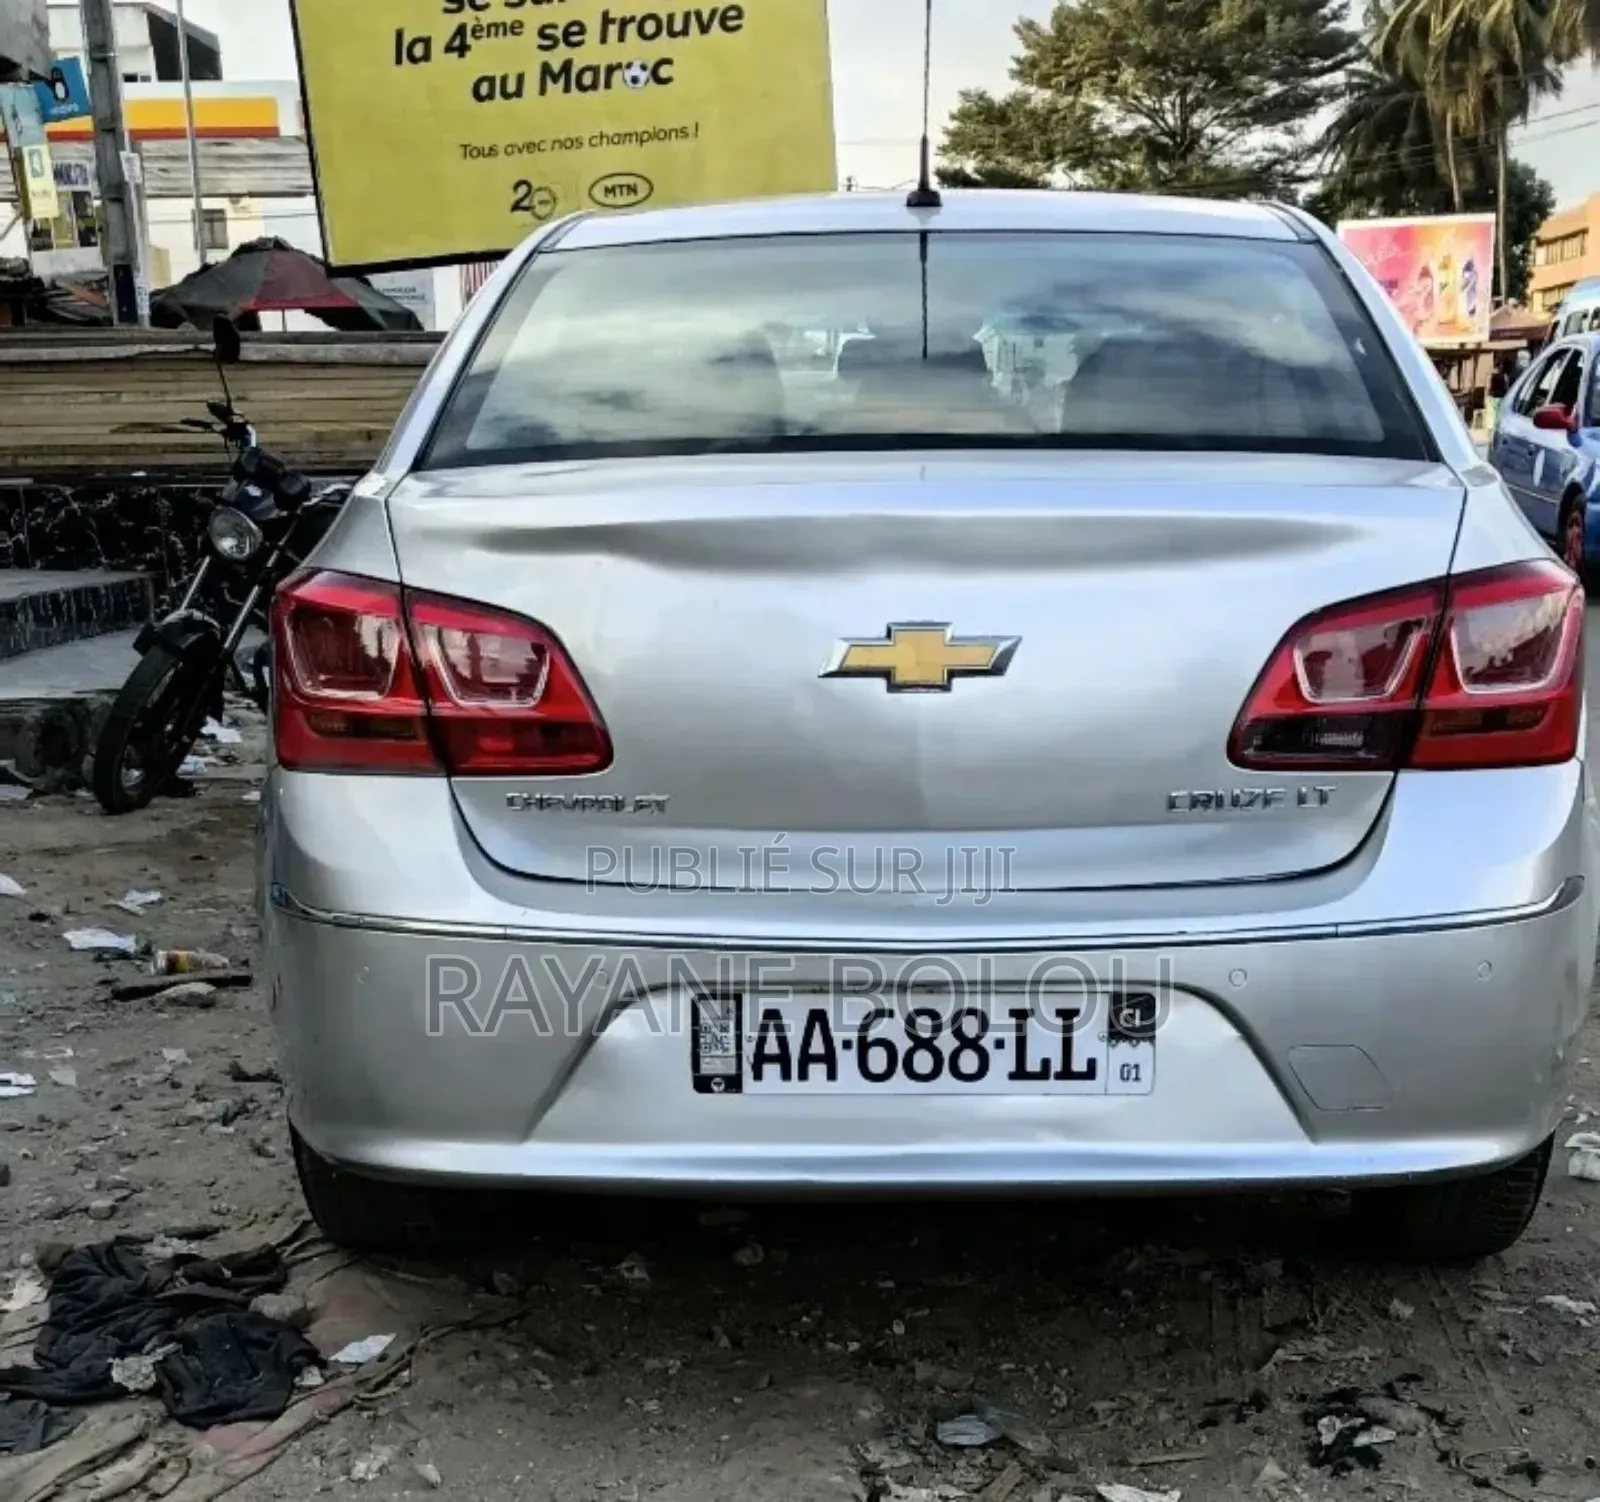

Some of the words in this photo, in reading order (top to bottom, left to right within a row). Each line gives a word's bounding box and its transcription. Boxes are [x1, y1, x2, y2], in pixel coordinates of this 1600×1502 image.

[394, 27, 432, 66] la
[443, 16, 525, 59] 4ème
[536, 20, 587, 52] se
[598, 3, 744, 45] trouve
[472, 71, 525, 103] au
[459, 143, 499, 160] Tous
[504, 138, 547, 156] avec
[550, 133, 584, 151] nos
[588, 124, 689, 148] champions
[603, 182, 638, 199] MTN
[505, 791, 671, 815] CHEVROLET
[1166, 787, 1287, 812] CRUZE
[1297, 785, 1337, 807] LT
[1119, 1062, 1143, 1083] 01
